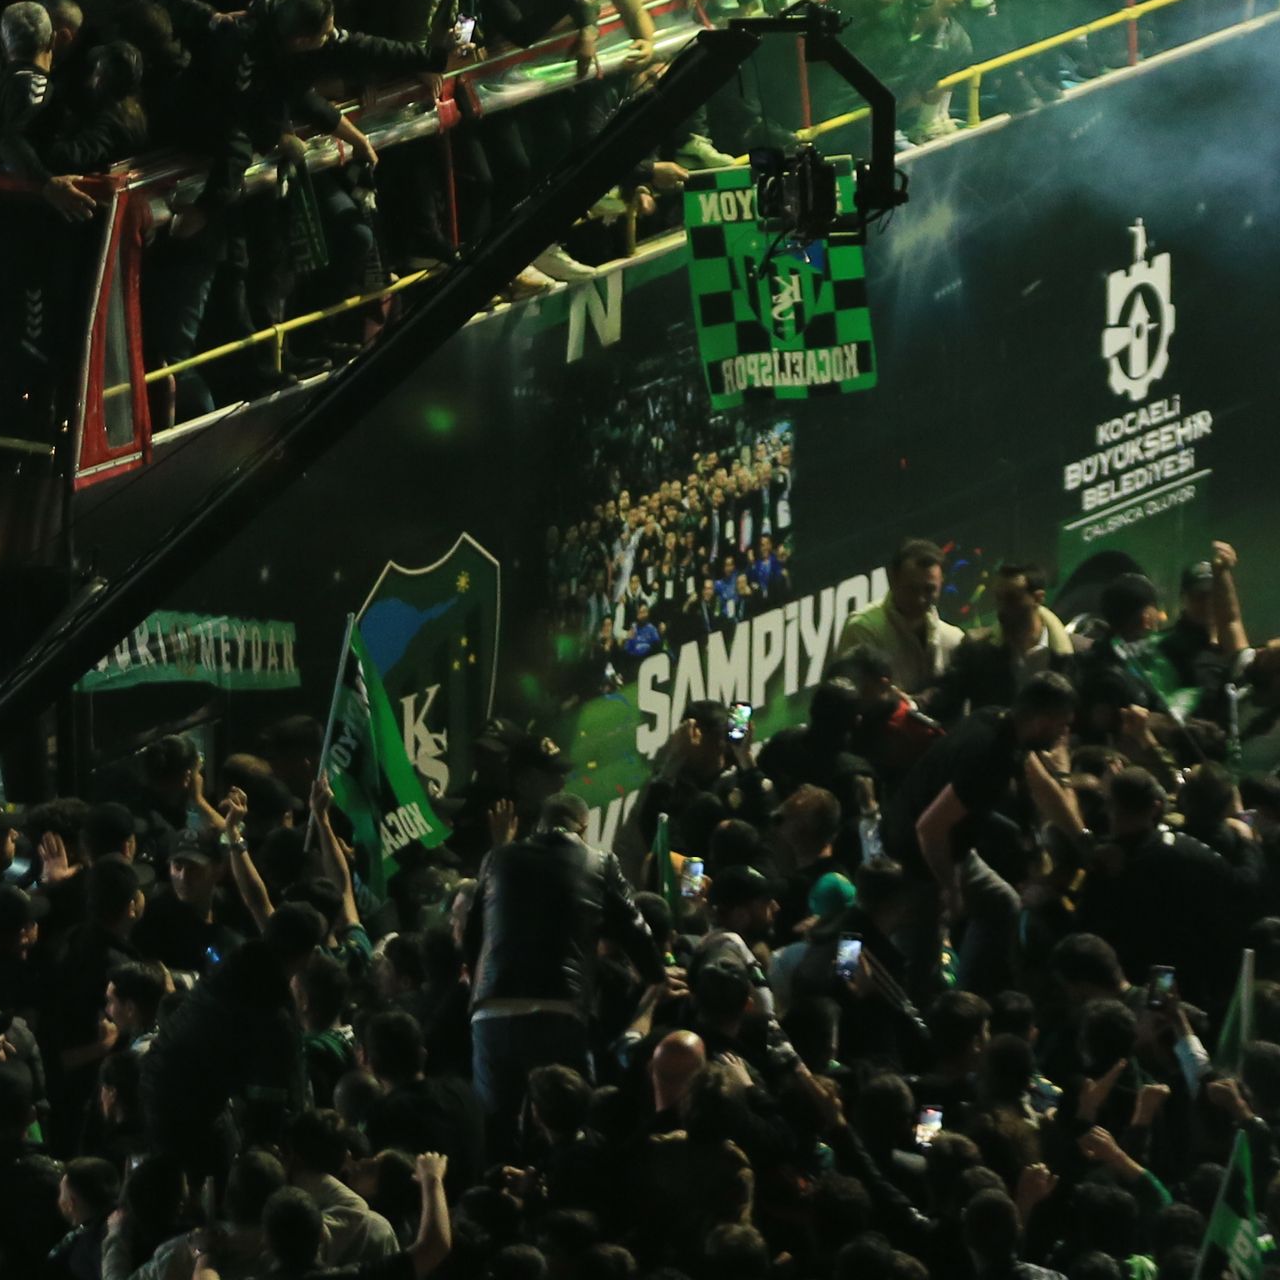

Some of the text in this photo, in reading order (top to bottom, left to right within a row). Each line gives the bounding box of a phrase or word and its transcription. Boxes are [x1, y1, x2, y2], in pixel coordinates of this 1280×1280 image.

[198, 621, 295, 673] MEYDAN
[636, 567, 889, 761] ŞAMPİYO
[400, 683, 449, 798] KS
